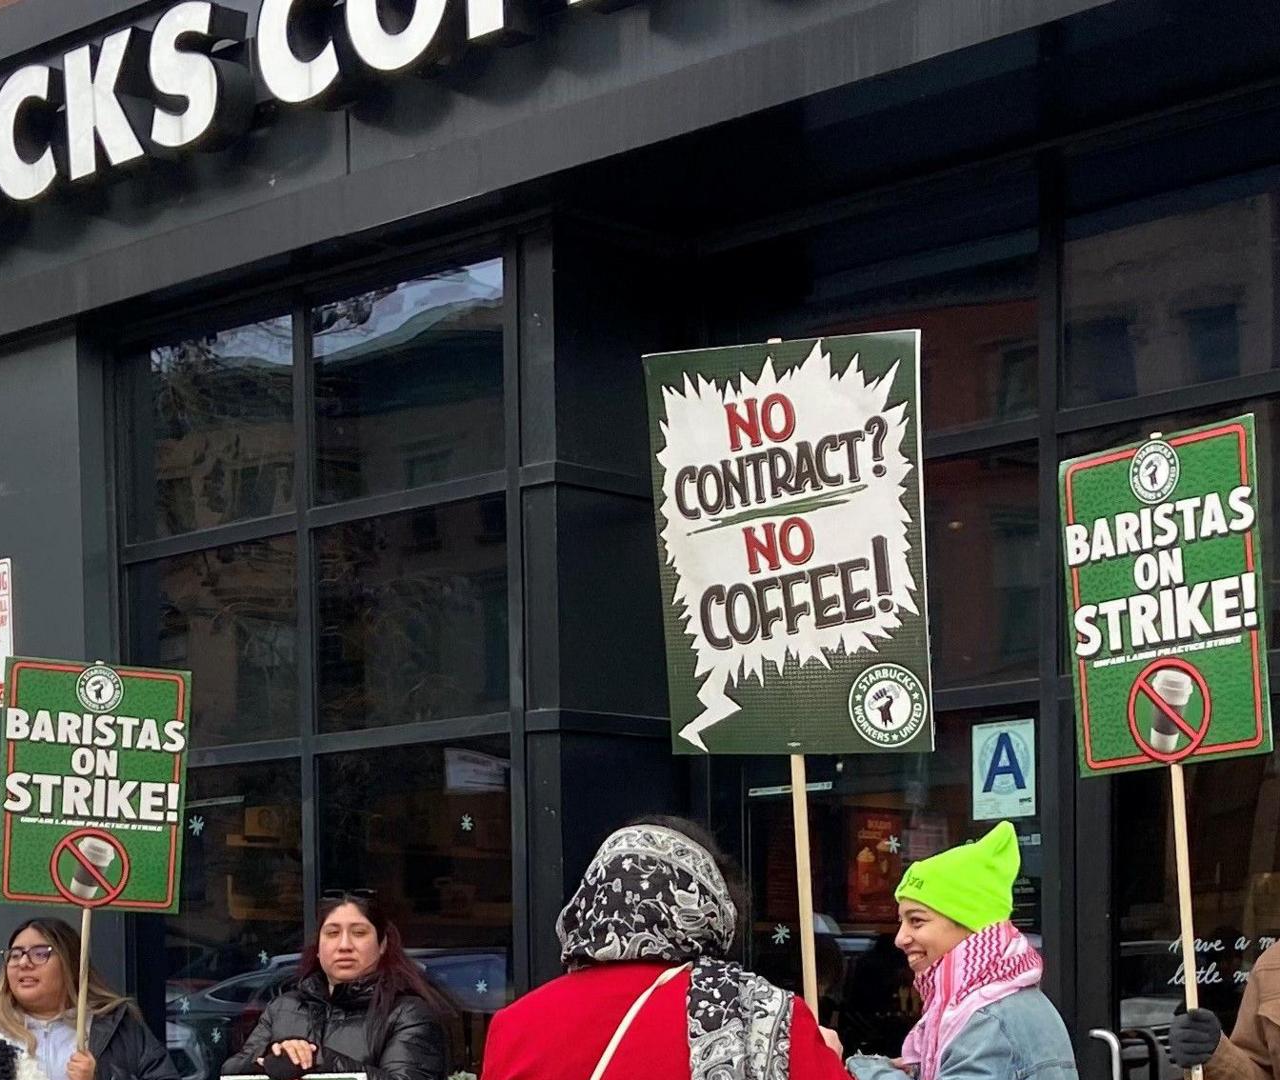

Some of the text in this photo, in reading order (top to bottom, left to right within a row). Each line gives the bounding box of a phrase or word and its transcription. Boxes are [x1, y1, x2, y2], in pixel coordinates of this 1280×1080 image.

[723, 392, 796, 452] NO
[674, 415, 888, 519] CONTRACT?
[742, 516, 815, 574] NO
[1065, 486, 1255, 567] BARISTAS
[700, 534, 894, 650] COFFEE!
[1134, 548, 1183, 591] ON
[1074, 572, 1258, 658] STRIKE!
[858, 669, 915, 692] STARBUCKS
[6, 708, 186, 752] BARISTAS
[854, 705, 890, 742] WORKERS
[899, 703, 922, 738] UNITED
[71, 748, 118, 778] ON
[982, 732, 1026, 793] A
[4, 772, 180, 822] STRIKE!
[1235, 935, 1252, 950] a
